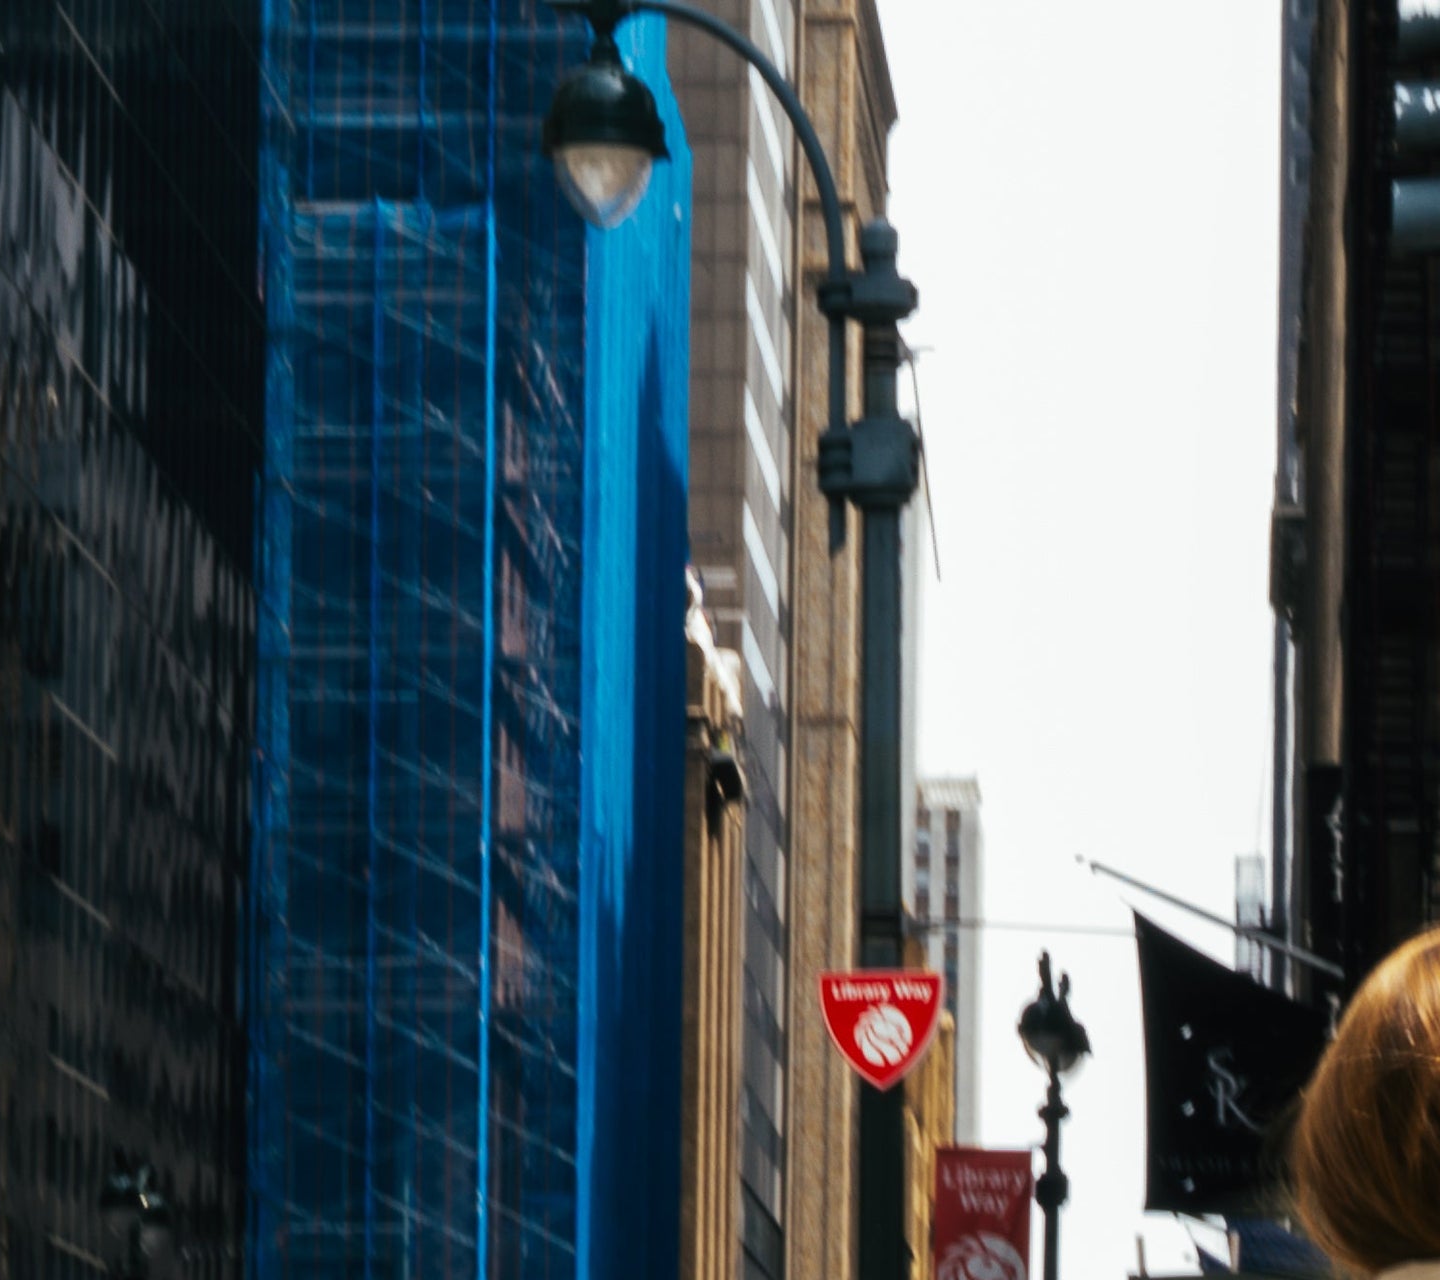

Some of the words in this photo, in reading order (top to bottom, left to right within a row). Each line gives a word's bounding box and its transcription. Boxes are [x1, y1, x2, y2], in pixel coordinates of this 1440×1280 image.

[830, 979, 891, 1003] Library
[893, 979, 933, 1005] Way
[942, 1161, 1027, 1198] Library
[961, 1191, 1009, 1219] Way
